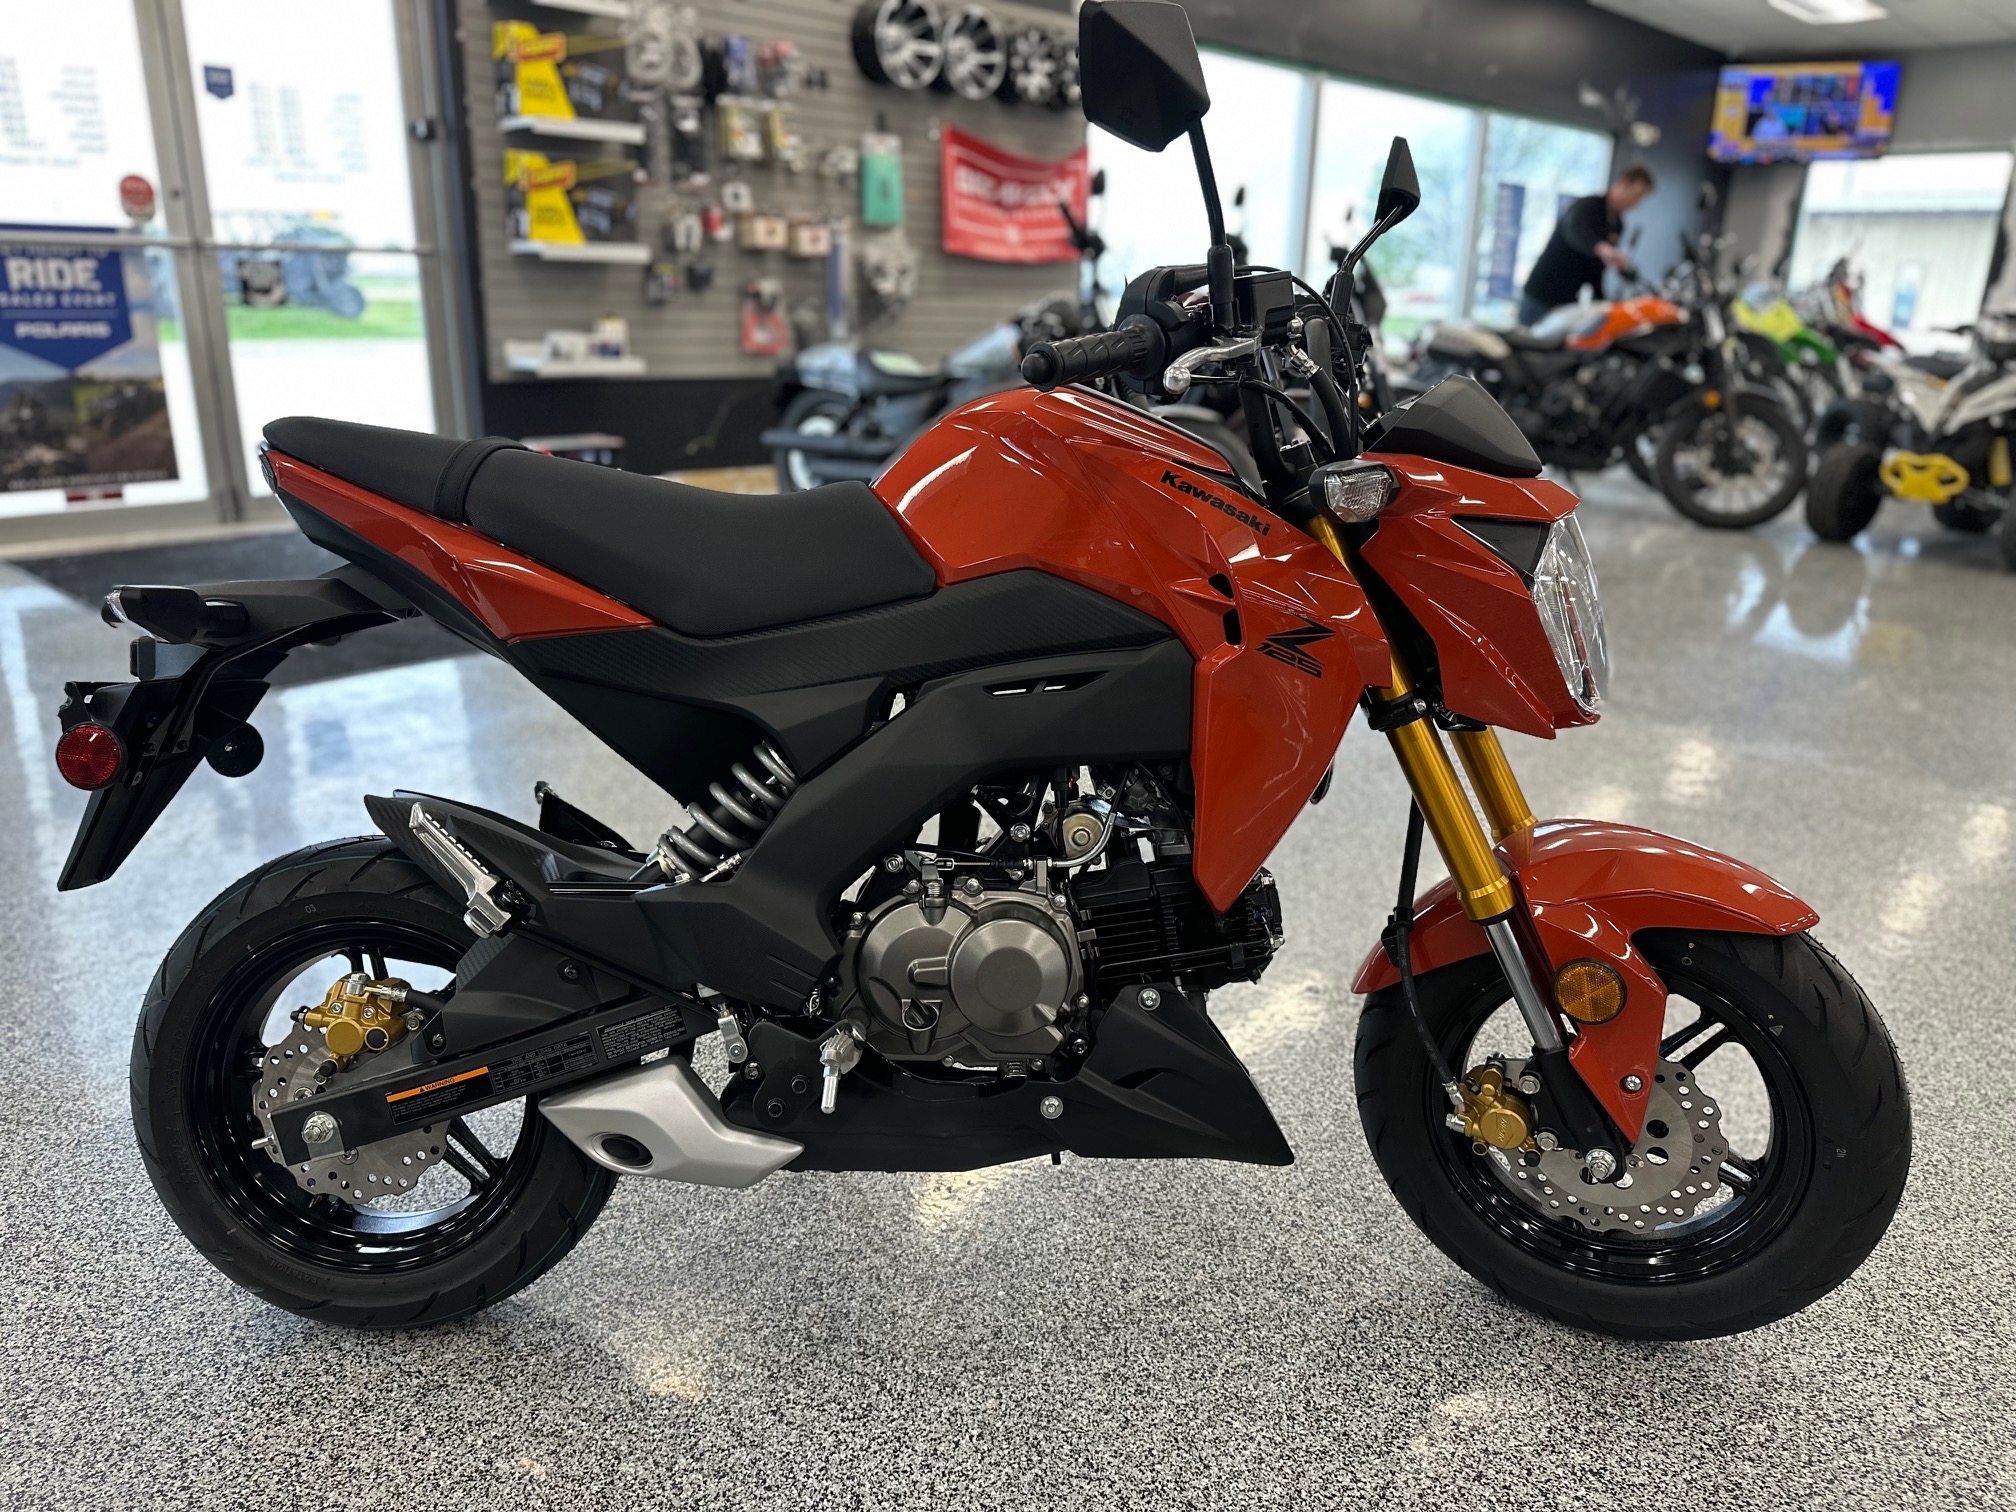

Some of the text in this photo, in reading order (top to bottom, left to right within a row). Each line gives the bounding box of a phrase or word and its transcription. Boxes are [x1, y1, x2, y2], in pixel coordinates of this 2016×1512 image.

[14, 320, 112, 339] POLARIS
[1159, 469, 1272, 537] Kawasaki
[1264, 613, 1337, 668] Z
[1254, 641, 1323, 679] 125
[554, 1042, 568, 1050] DATA
[425, 1077, 456, 1090] WARNING
[271, 1258, 319, 1285] ROTATION
